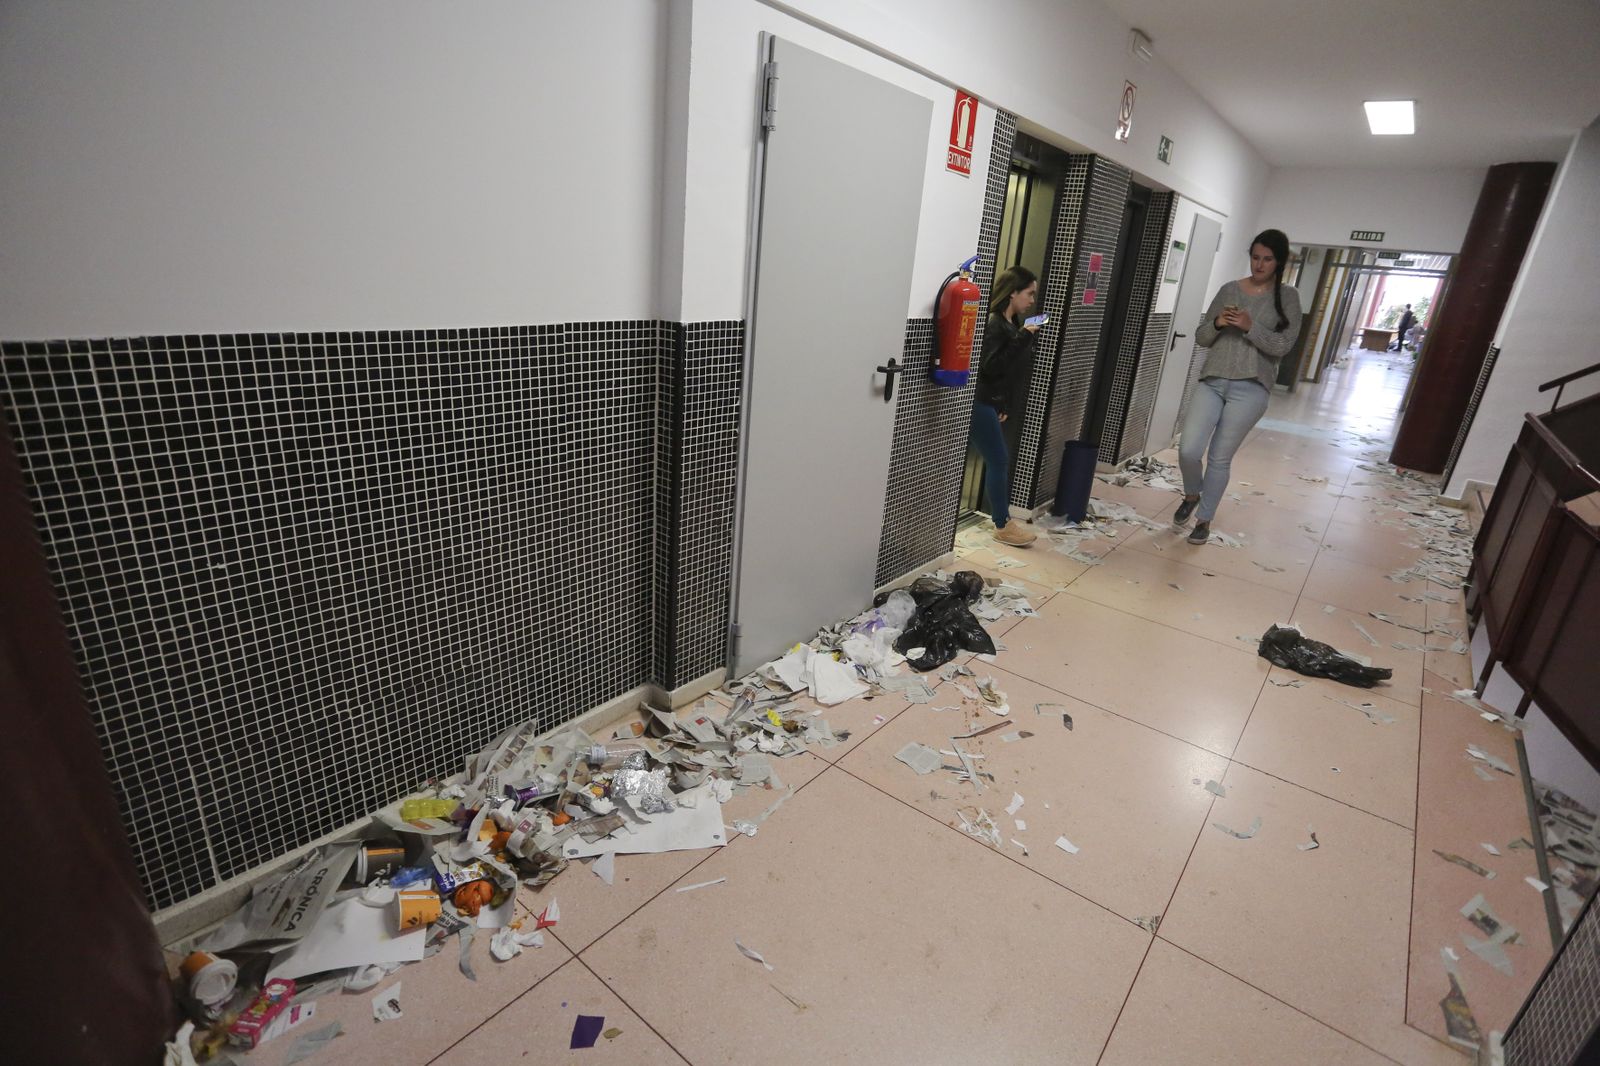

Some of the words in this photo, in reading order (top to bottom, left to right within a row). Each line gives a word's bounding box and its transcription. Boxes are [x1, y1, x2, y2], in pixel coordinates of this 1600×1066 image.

[947, 151, 972, 170] EXTINTOR
[1352, 231, 1383, 241] SALIDA
[284, 867, 329, 932] CRÓNICA
